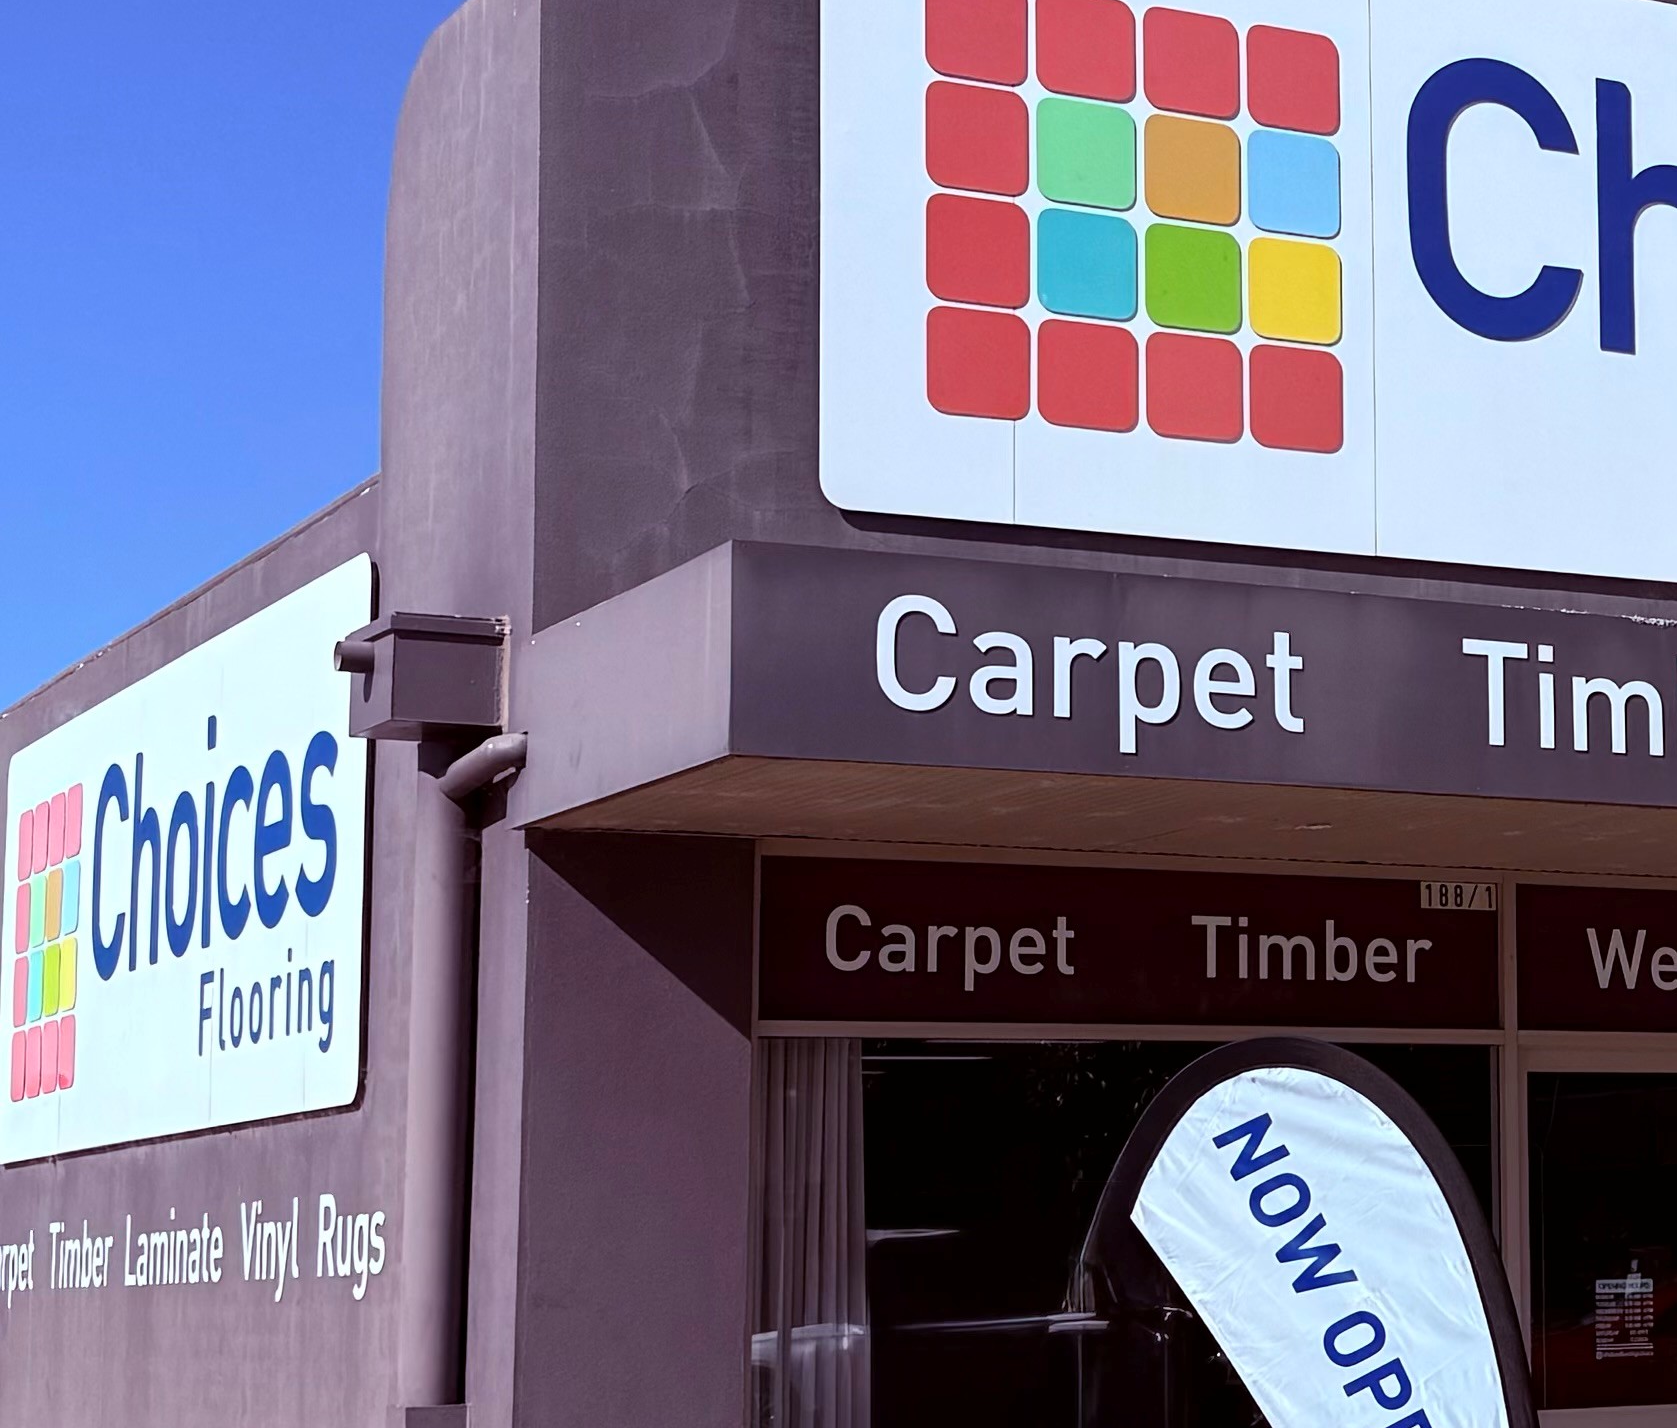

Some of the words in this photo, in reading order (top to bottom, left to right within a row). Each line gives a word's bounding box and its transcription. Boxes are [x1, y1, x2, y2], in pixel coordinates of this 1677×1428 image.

[875, 593, 1306, 755] Carpet
[91, 715, 340, 982] Choices
[1425, 883, 1493, 909] 188/1
[198, 947, 335, 1057] Flooring
[824, 904, 1076, 992] Carpet
[1191, 915, 1433, 984] Timber
[0, 1230, 34, 1309] rpet
[50, 1219, 113, 1289] Timber
[124, 1207, 223, 1286] Laminate
[240, 1196, 299, 1302] Vinyl
[317, 1193, 385, 1300] Rugs
[1212, 1112, 1358, 1294] NOW
